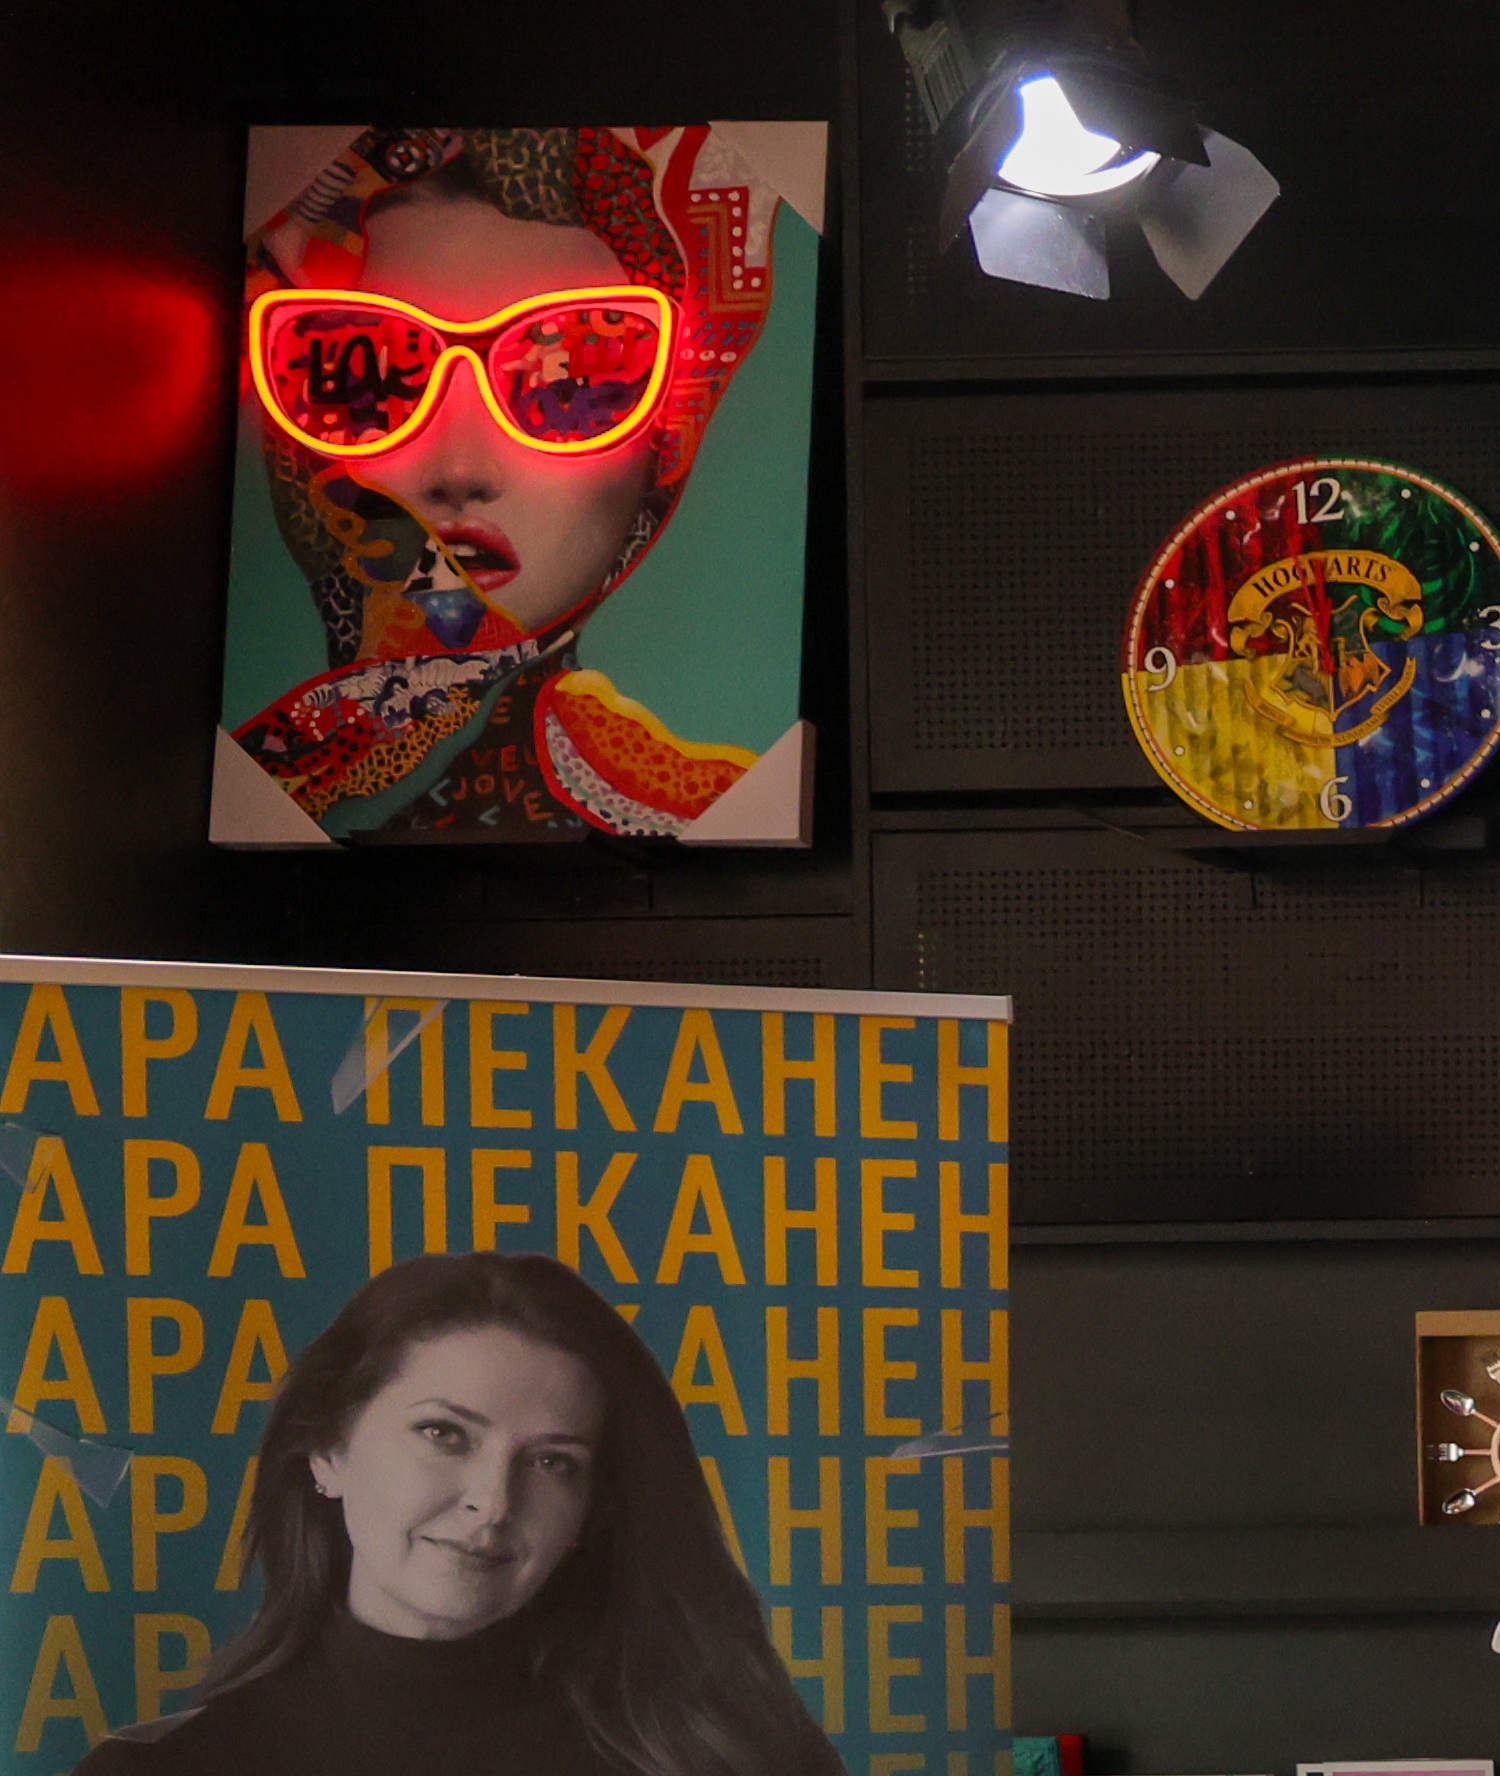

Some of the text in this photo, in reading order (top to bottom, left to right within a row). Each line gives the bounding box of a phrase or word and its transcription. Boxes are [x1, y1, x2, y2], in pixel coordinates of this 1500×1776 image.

[1291, 477, 1346, 526] 12
[1143, 646, 1178, 693] 9
[1319, 776, 1353, 823] 6
[364, 995, 1009, 1143] ПЕКАНЕН
[366, 1145, 1009, 1289] ПЕКАНЕН
